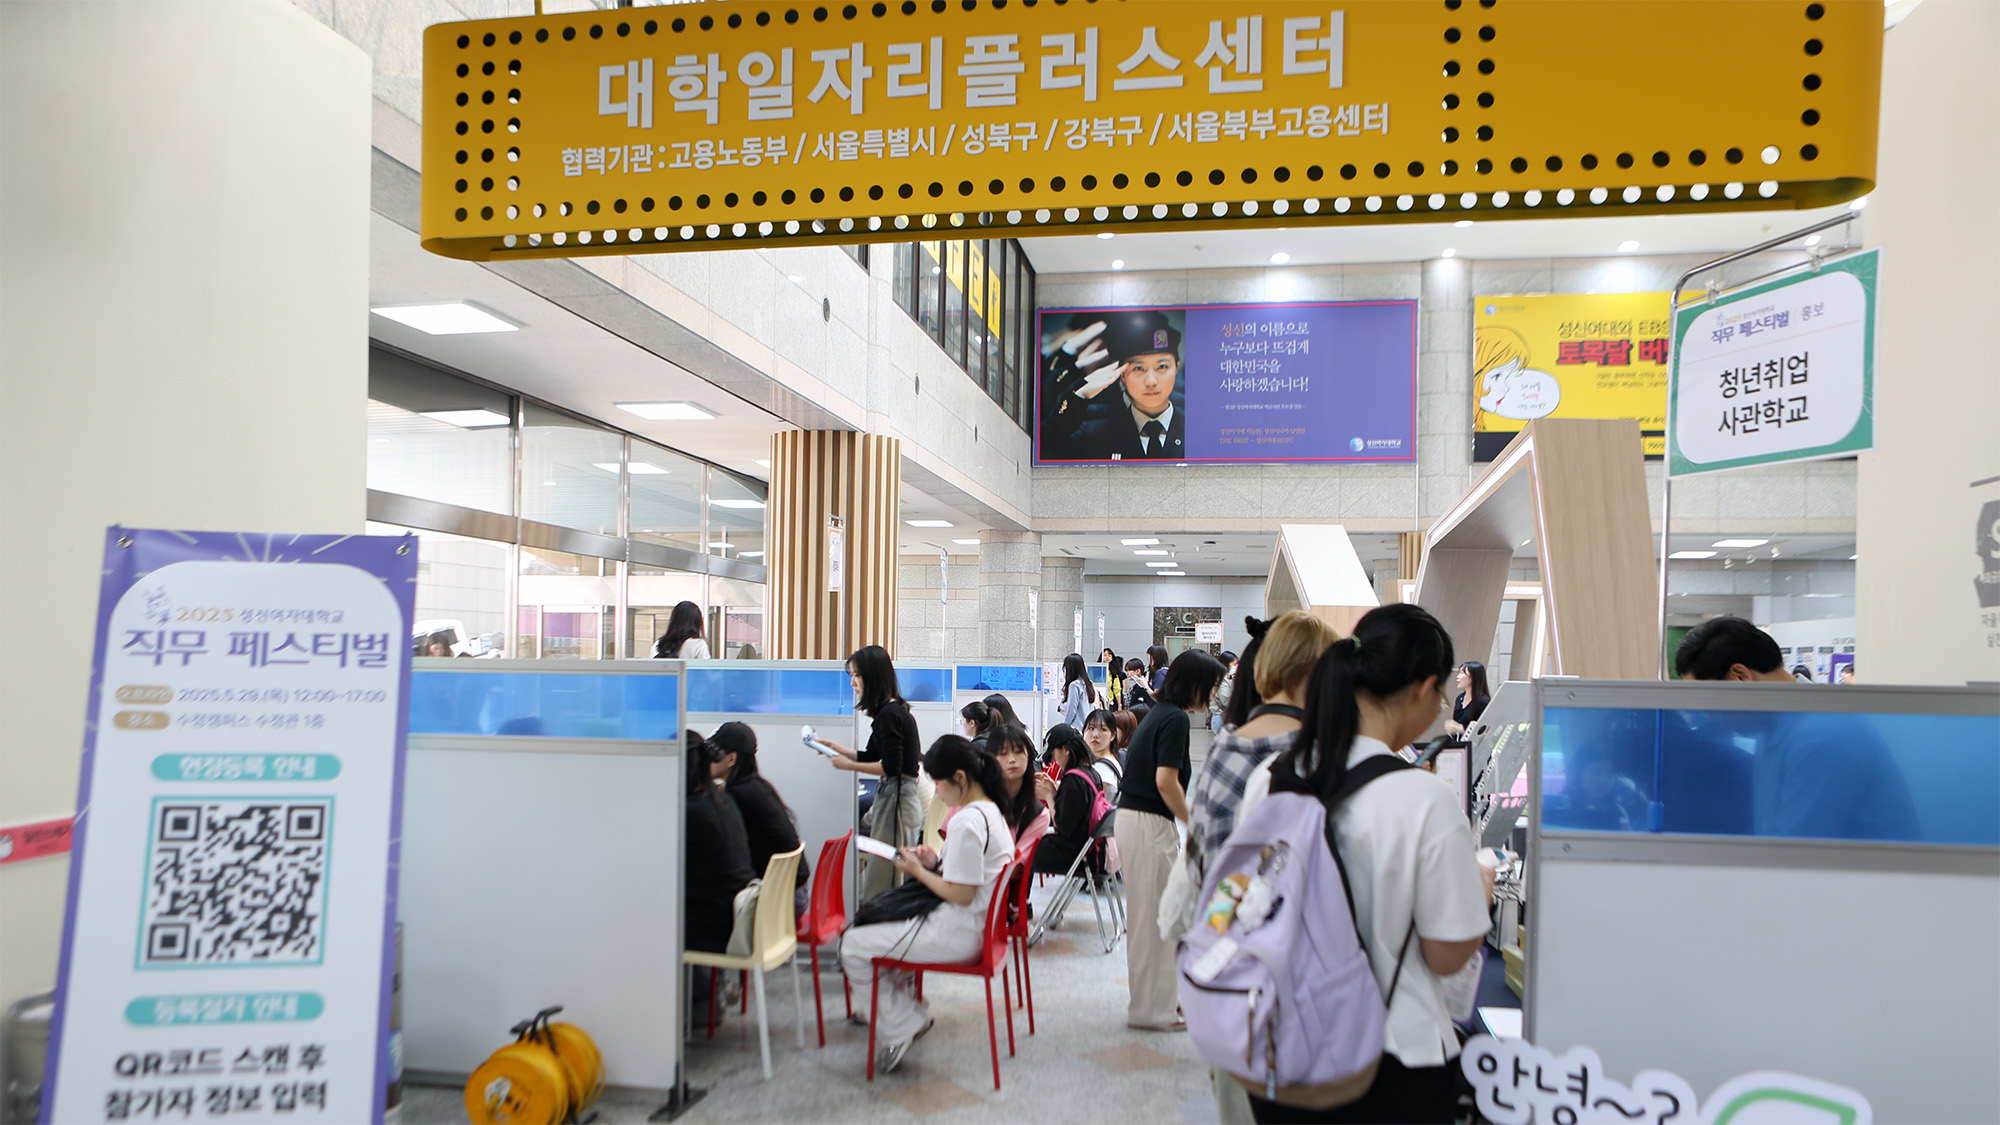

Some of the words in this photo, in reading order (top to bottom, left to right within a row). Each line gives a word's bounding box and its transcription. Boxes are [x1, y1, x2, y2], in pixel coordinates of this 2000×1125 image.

[598, 9, 1345, 129] 대학일자리플러스센터
[669, 134, 789, 170] 고용노동부
[812, 124, 937, 162] 서울특별시
[960, 121, 1039, 155] 성북구
[1063, 115, 1144, 149] 강북구
[1167, 102, 1390, 144] 서울북부고용센터
[1801, 302, 1825, 322] 홍보
[1220, 321, 1257, 338] 성신의
[1259, 321, 1310, 338] 이름으로
[1558, 319, 1633, 339] 성신여대와
[1711, 326, 1735, 344] 직무
[1739, 310, 1790, 337] 페스티벌
[1219, 340, 1269, 356] 누구보다
[1271, 339, 1310, 355] 뜨겁게
[1556, 339, 1634, 366] 토목달
[1219, 358, 1282, 375] 대한민국을
[1718, 351, 1809, 399] 청년취업
[1219, 376, 1310, 393] 사랑하겠습니다!
[1717, 395, 1810, 437] 사관학교
[175, 607, 234, 624] 2025
[239, 607, 344, 625] 성신여자대학교
[122, 628, 209, 667] 직무
[226, 631, 390, 669] 페스티벌
[175, 713, 251, 729] 수정캠퍼스
[255, 713, 300, 729] 수정관
[179, 756, 265, 779] 현장등록
[272, 756, 317, 778] 안내
[154, 998, 246, 1024] 등록절차
[252, 995, 300, 1022] 안내
[114, 1047, 225, 1079] QR코드
[230, 1045, 289, 1075] 스캔
[297, 1043, 326, 1074] 후
[104, 1086, 196, 1122] 참가자
[203, 1084, 264, 1115] 정보
[271, 1081, 329, 1114] 입력
